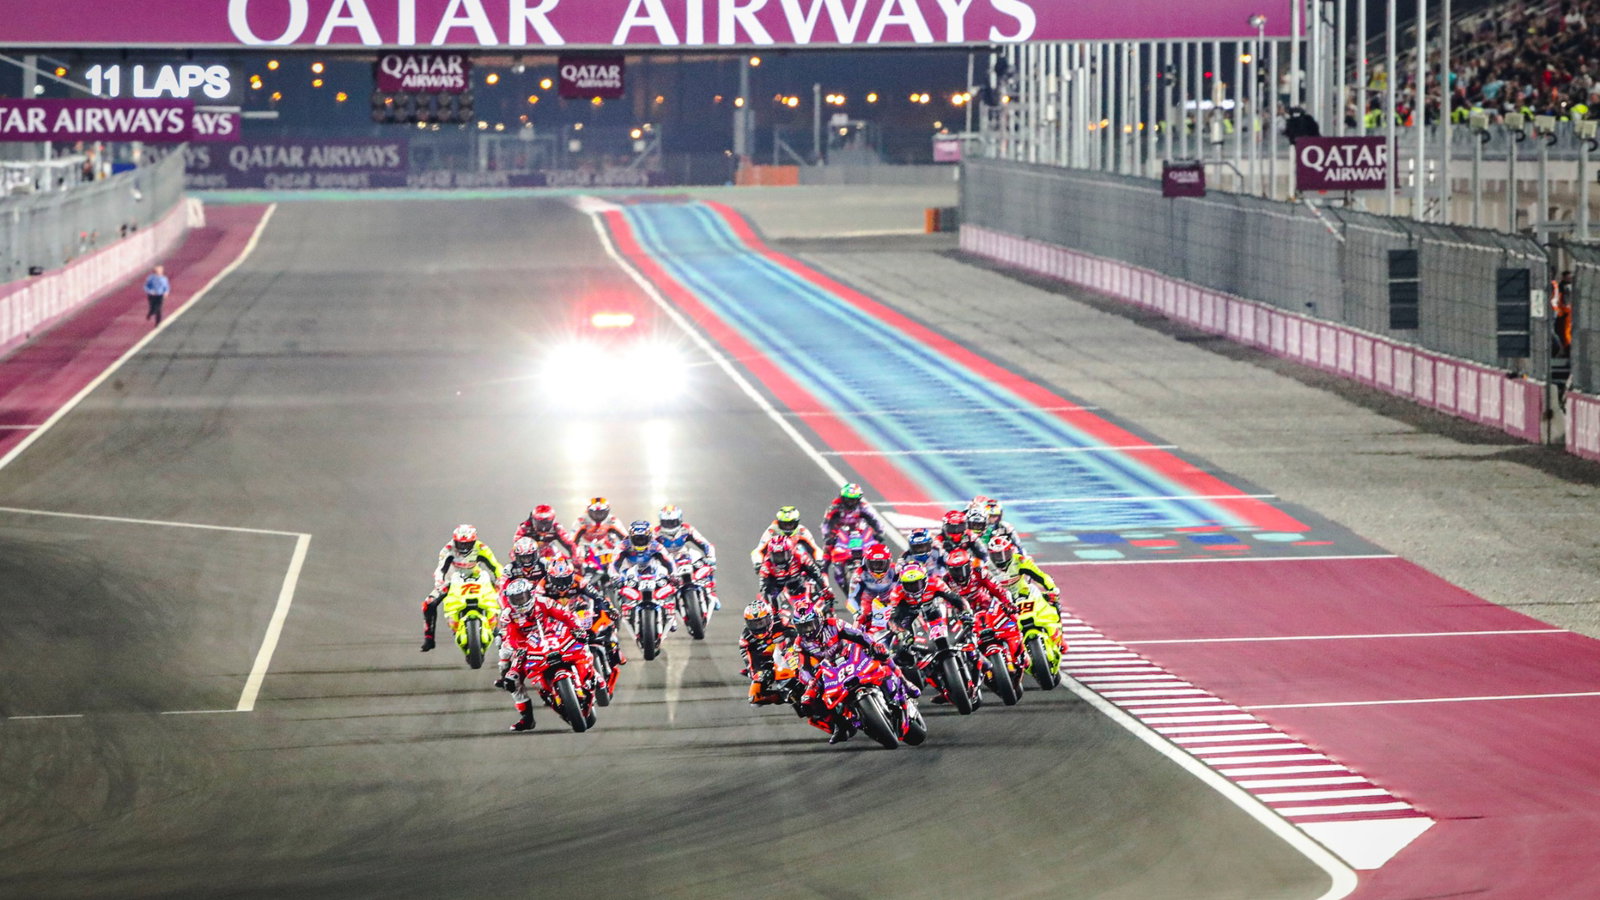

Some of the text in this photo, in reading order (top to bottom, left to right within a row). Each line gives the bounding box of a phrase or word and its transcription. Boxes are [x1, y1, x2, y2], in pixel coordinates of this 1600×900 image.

[381, 54, 463, 79] QATAR
[561, 64, 621, 82] QATAR
[85, 65, 231, 98] 11 LAPS
[401, 74, 465, 88] AIRWAYS
[53, 107, 185, 134] AIRWAYS
[229, 144, 304, 171] QATAR
[308, 144, 401, 169] AIRWAYS
[1301, 145, 1388, 172] QATAR
[1324, 167, 1387, 181] AIRWAY
[461, 583, 481, 595] 72
[838, 663, 855, 683] 89
